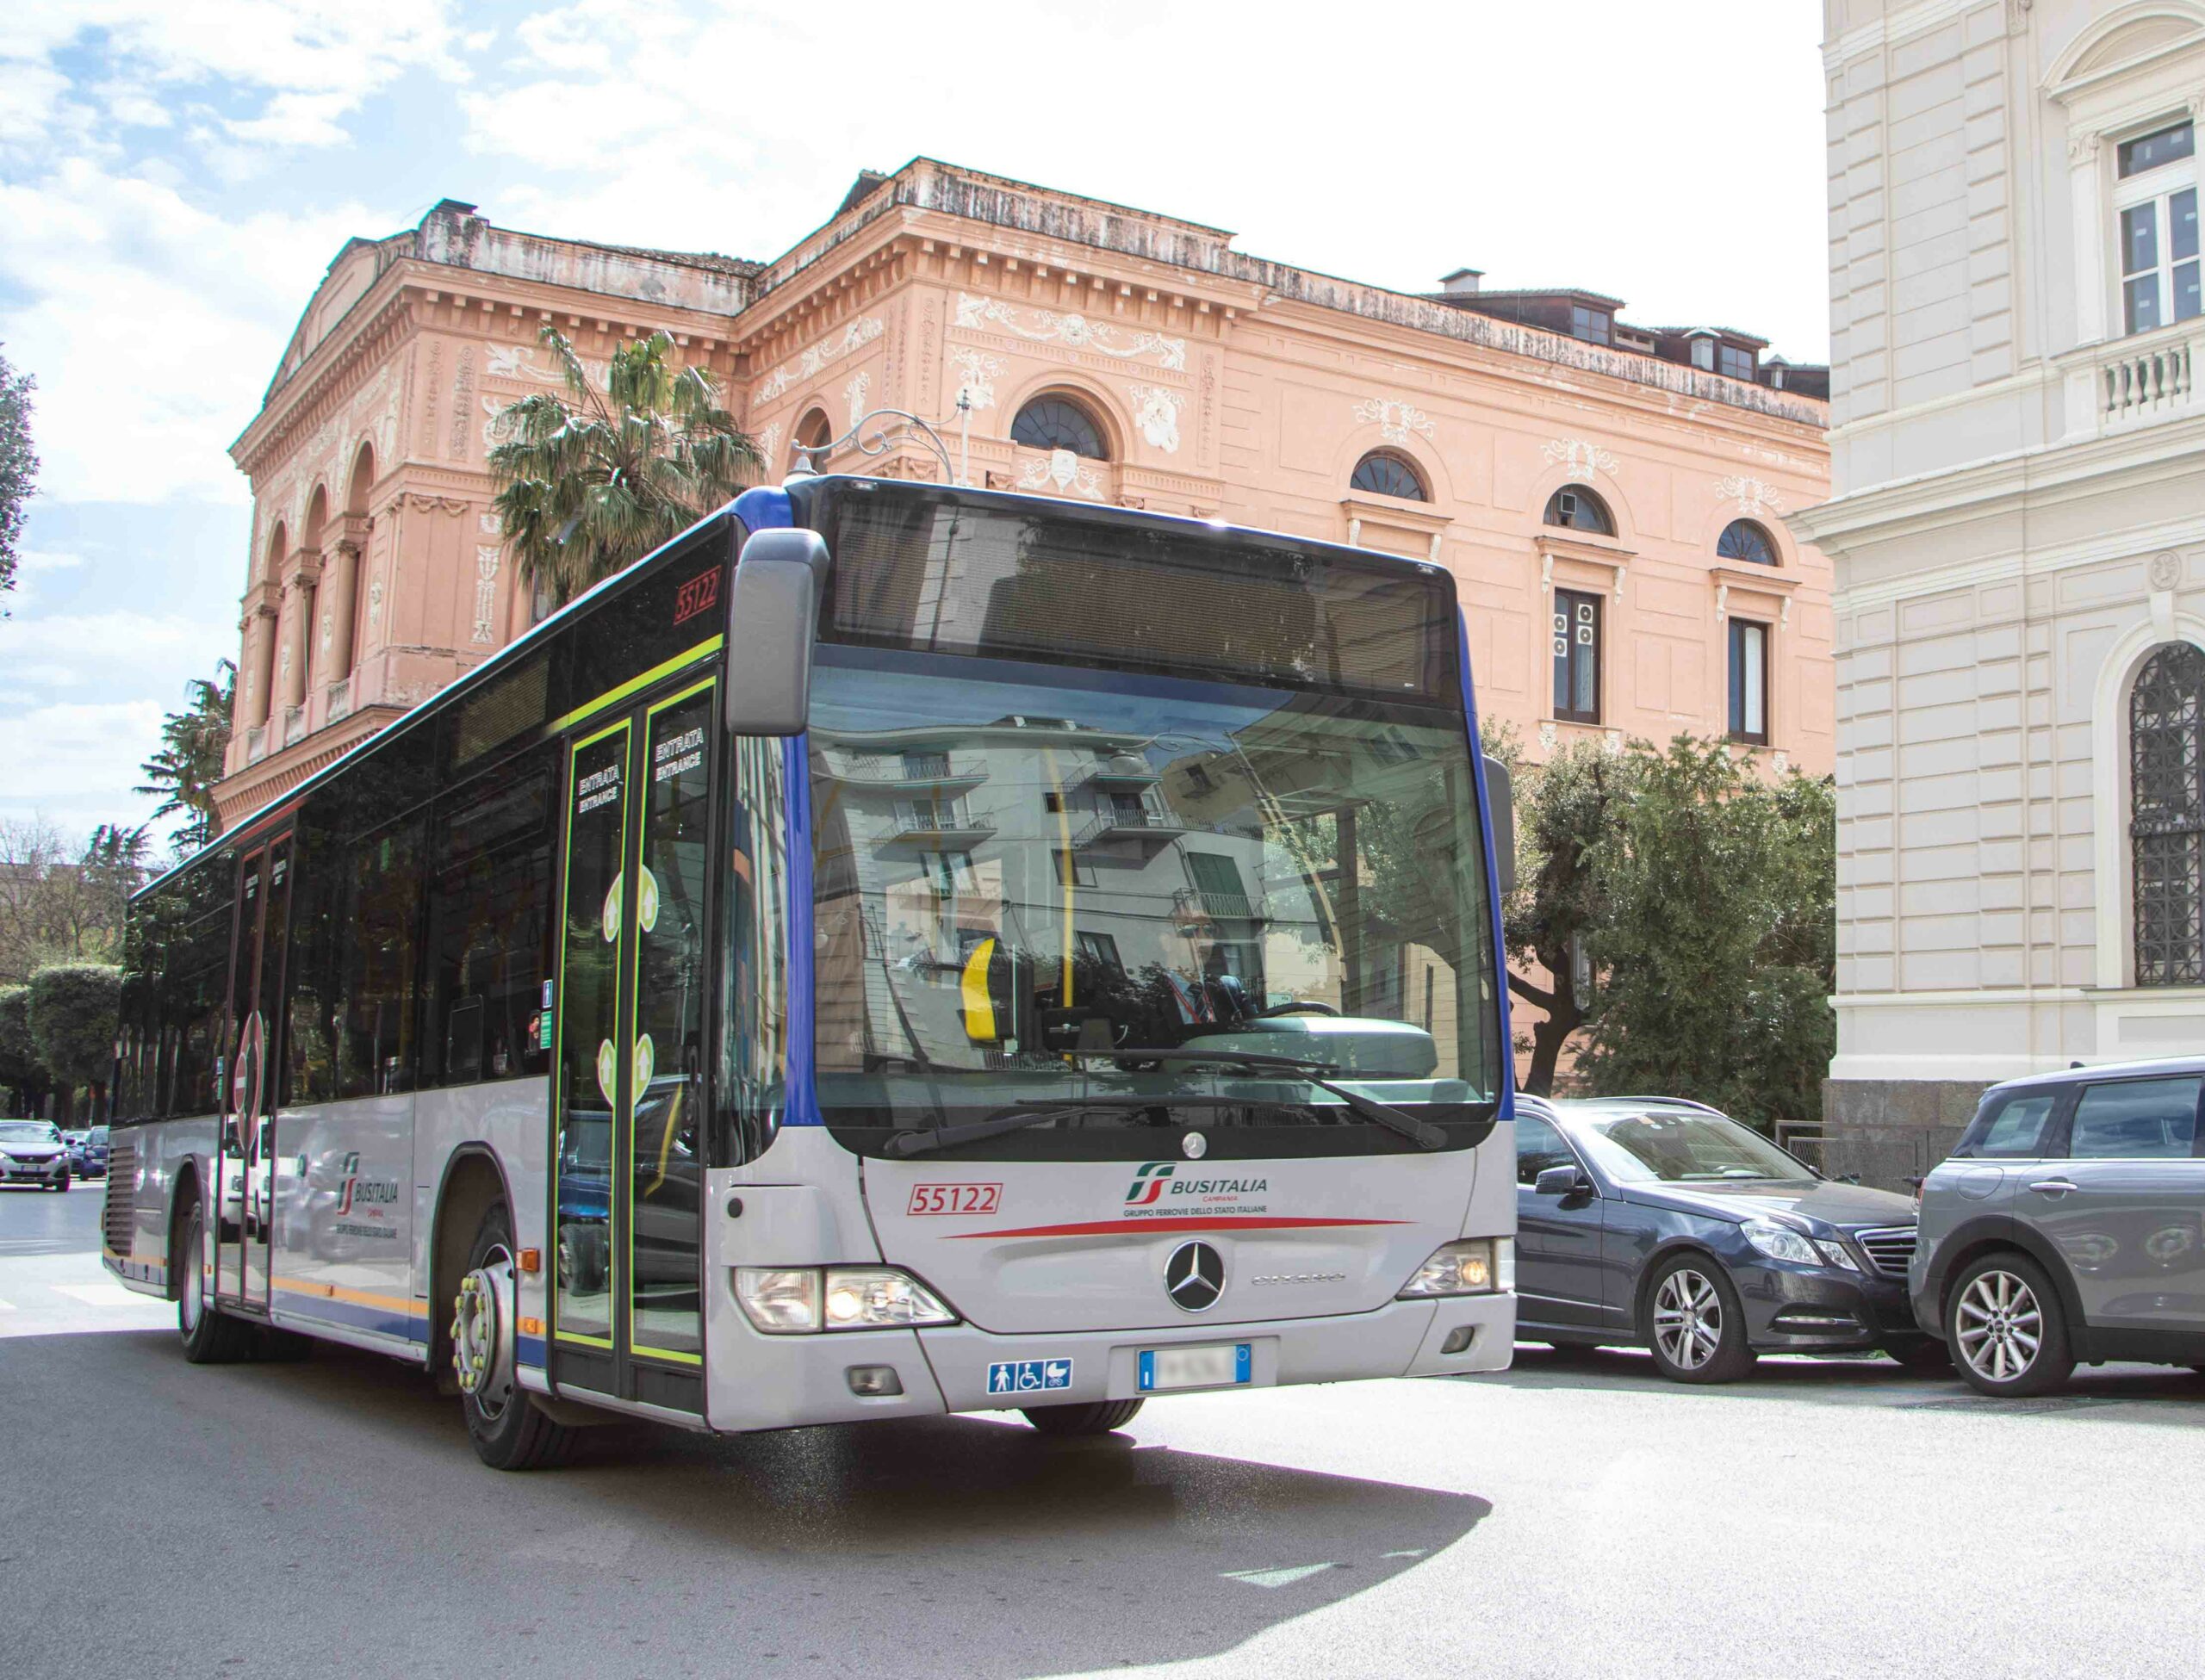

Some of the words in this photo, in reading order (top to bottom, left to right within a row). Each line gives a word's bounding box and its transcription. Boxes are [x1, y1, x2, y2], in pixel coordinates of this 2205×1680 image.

[674, 572, 717, 620] 55122
[655, 728, 705, 762] ENTRATA
[655, 751, 702, 782] ENTRANCE
[579, 764, 620, 796] ENTRATA
[579, 786, 618, 814] ENTRANCE
[356, 1182, 398, 1204] BUSITALIA
[913, 1187, 996, 1212] 55122
[1171, 1179, 1268, 1194] BUSITALIA
[1124, 1208, 1154, 1218] GRUPPO
[1156, 1207, 1189, 1217] FERROVIE
[1191, 1206, 1212, 1215] DELLO
[1214, 1206, 1235, 1215] STATO
[1252, 1273, 1346, 1286] CITARO
